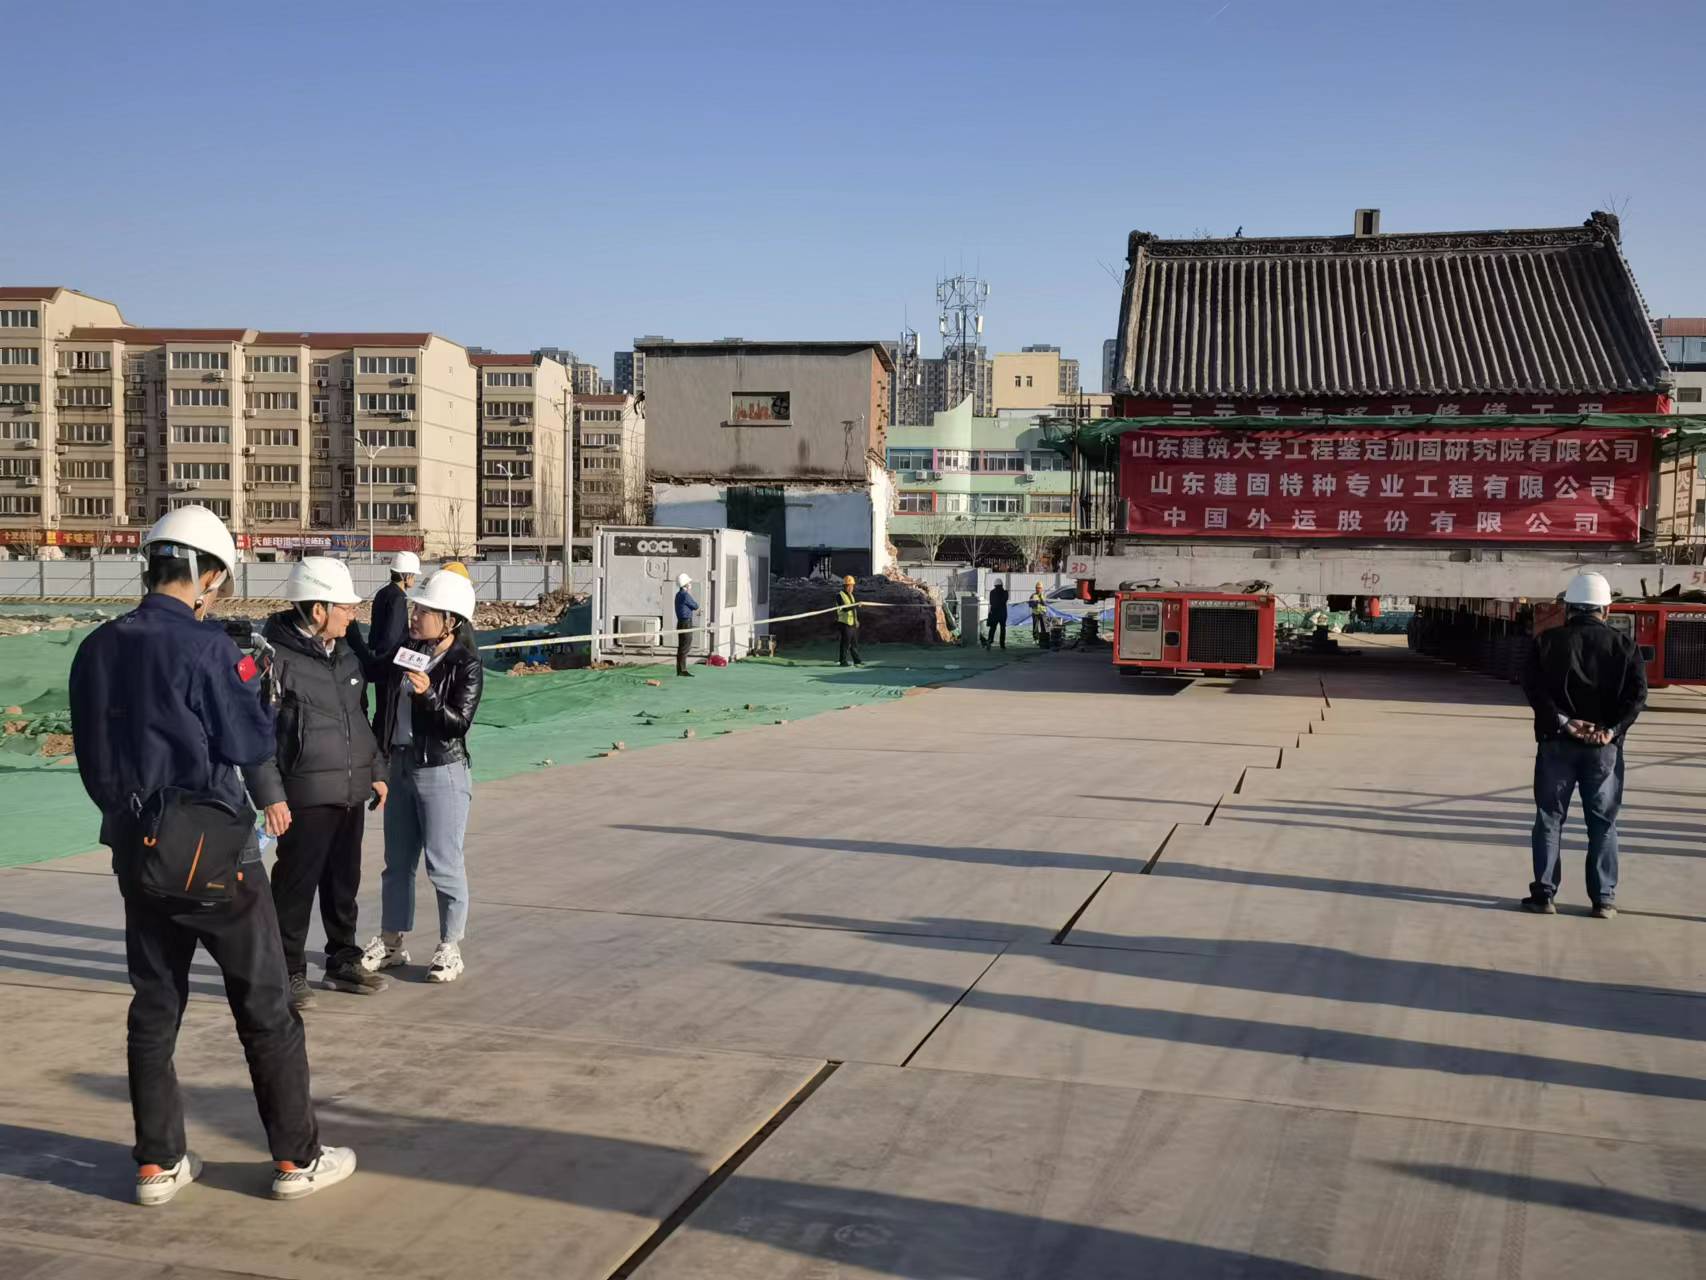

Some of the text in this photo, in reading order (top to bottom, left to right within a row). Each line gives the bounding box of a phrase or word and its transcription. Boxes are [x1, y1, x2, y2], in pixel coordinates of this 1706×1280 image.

[1132, 437, 1639, 463] 山东建筑大学工程鉴定加固研究院有限公司
[1151, 471, 1615, 500] 山东建固特种专业工程有限公司
[1163, 506, 1599, 534] 中国外运股份有限公司
[637, 540, 677, 553] OOCL
[1071, 562, 1088, 573] 3D
